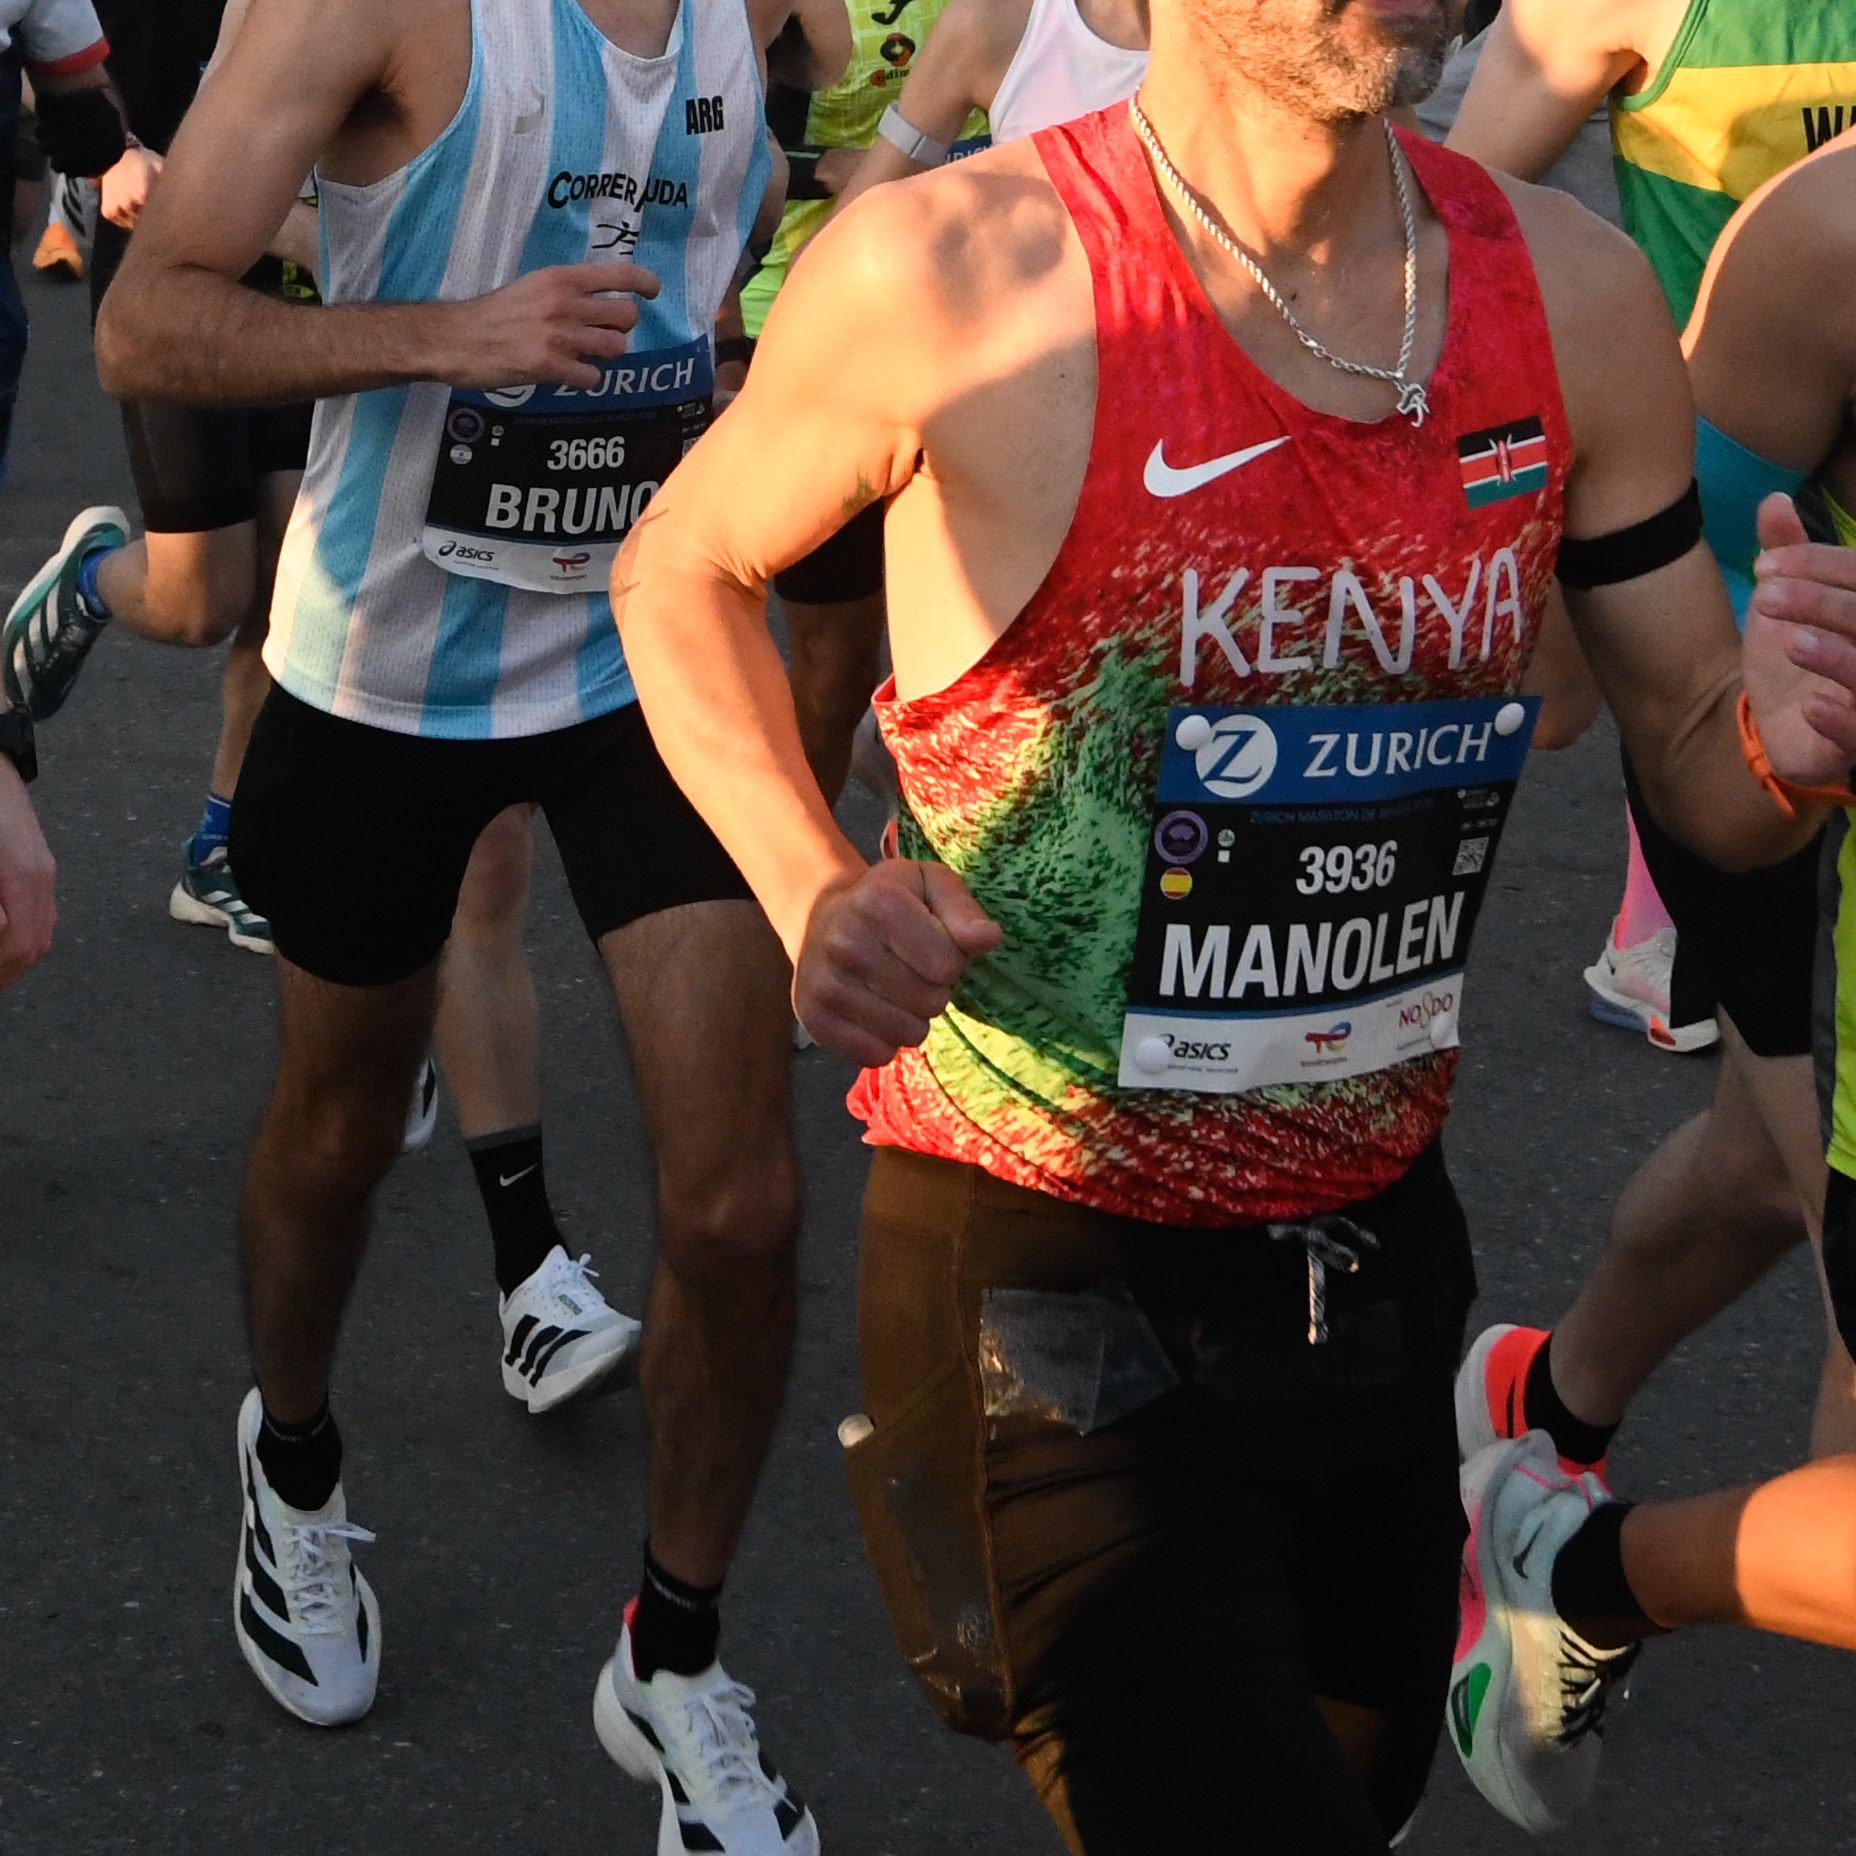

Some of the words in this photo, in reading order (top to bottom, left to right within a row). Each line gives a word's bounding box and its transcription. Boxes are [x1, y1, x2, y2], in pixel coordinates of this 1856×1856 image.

[685, 95, 724, 135] ARG
[547, 171, 637, 209] CORRER
[546, 436, 625, 471] 3666
[456, 547, 495, 562] asics
[1180, 547, 1521, 686] KENYA
[1303, 722, 1492, 778] ZURICH
[1295, 840, 1398, 896] 3936
[1159, 891, 1465, 999] MANOLEN
[1173, 1040, 1232, 1061] asics
